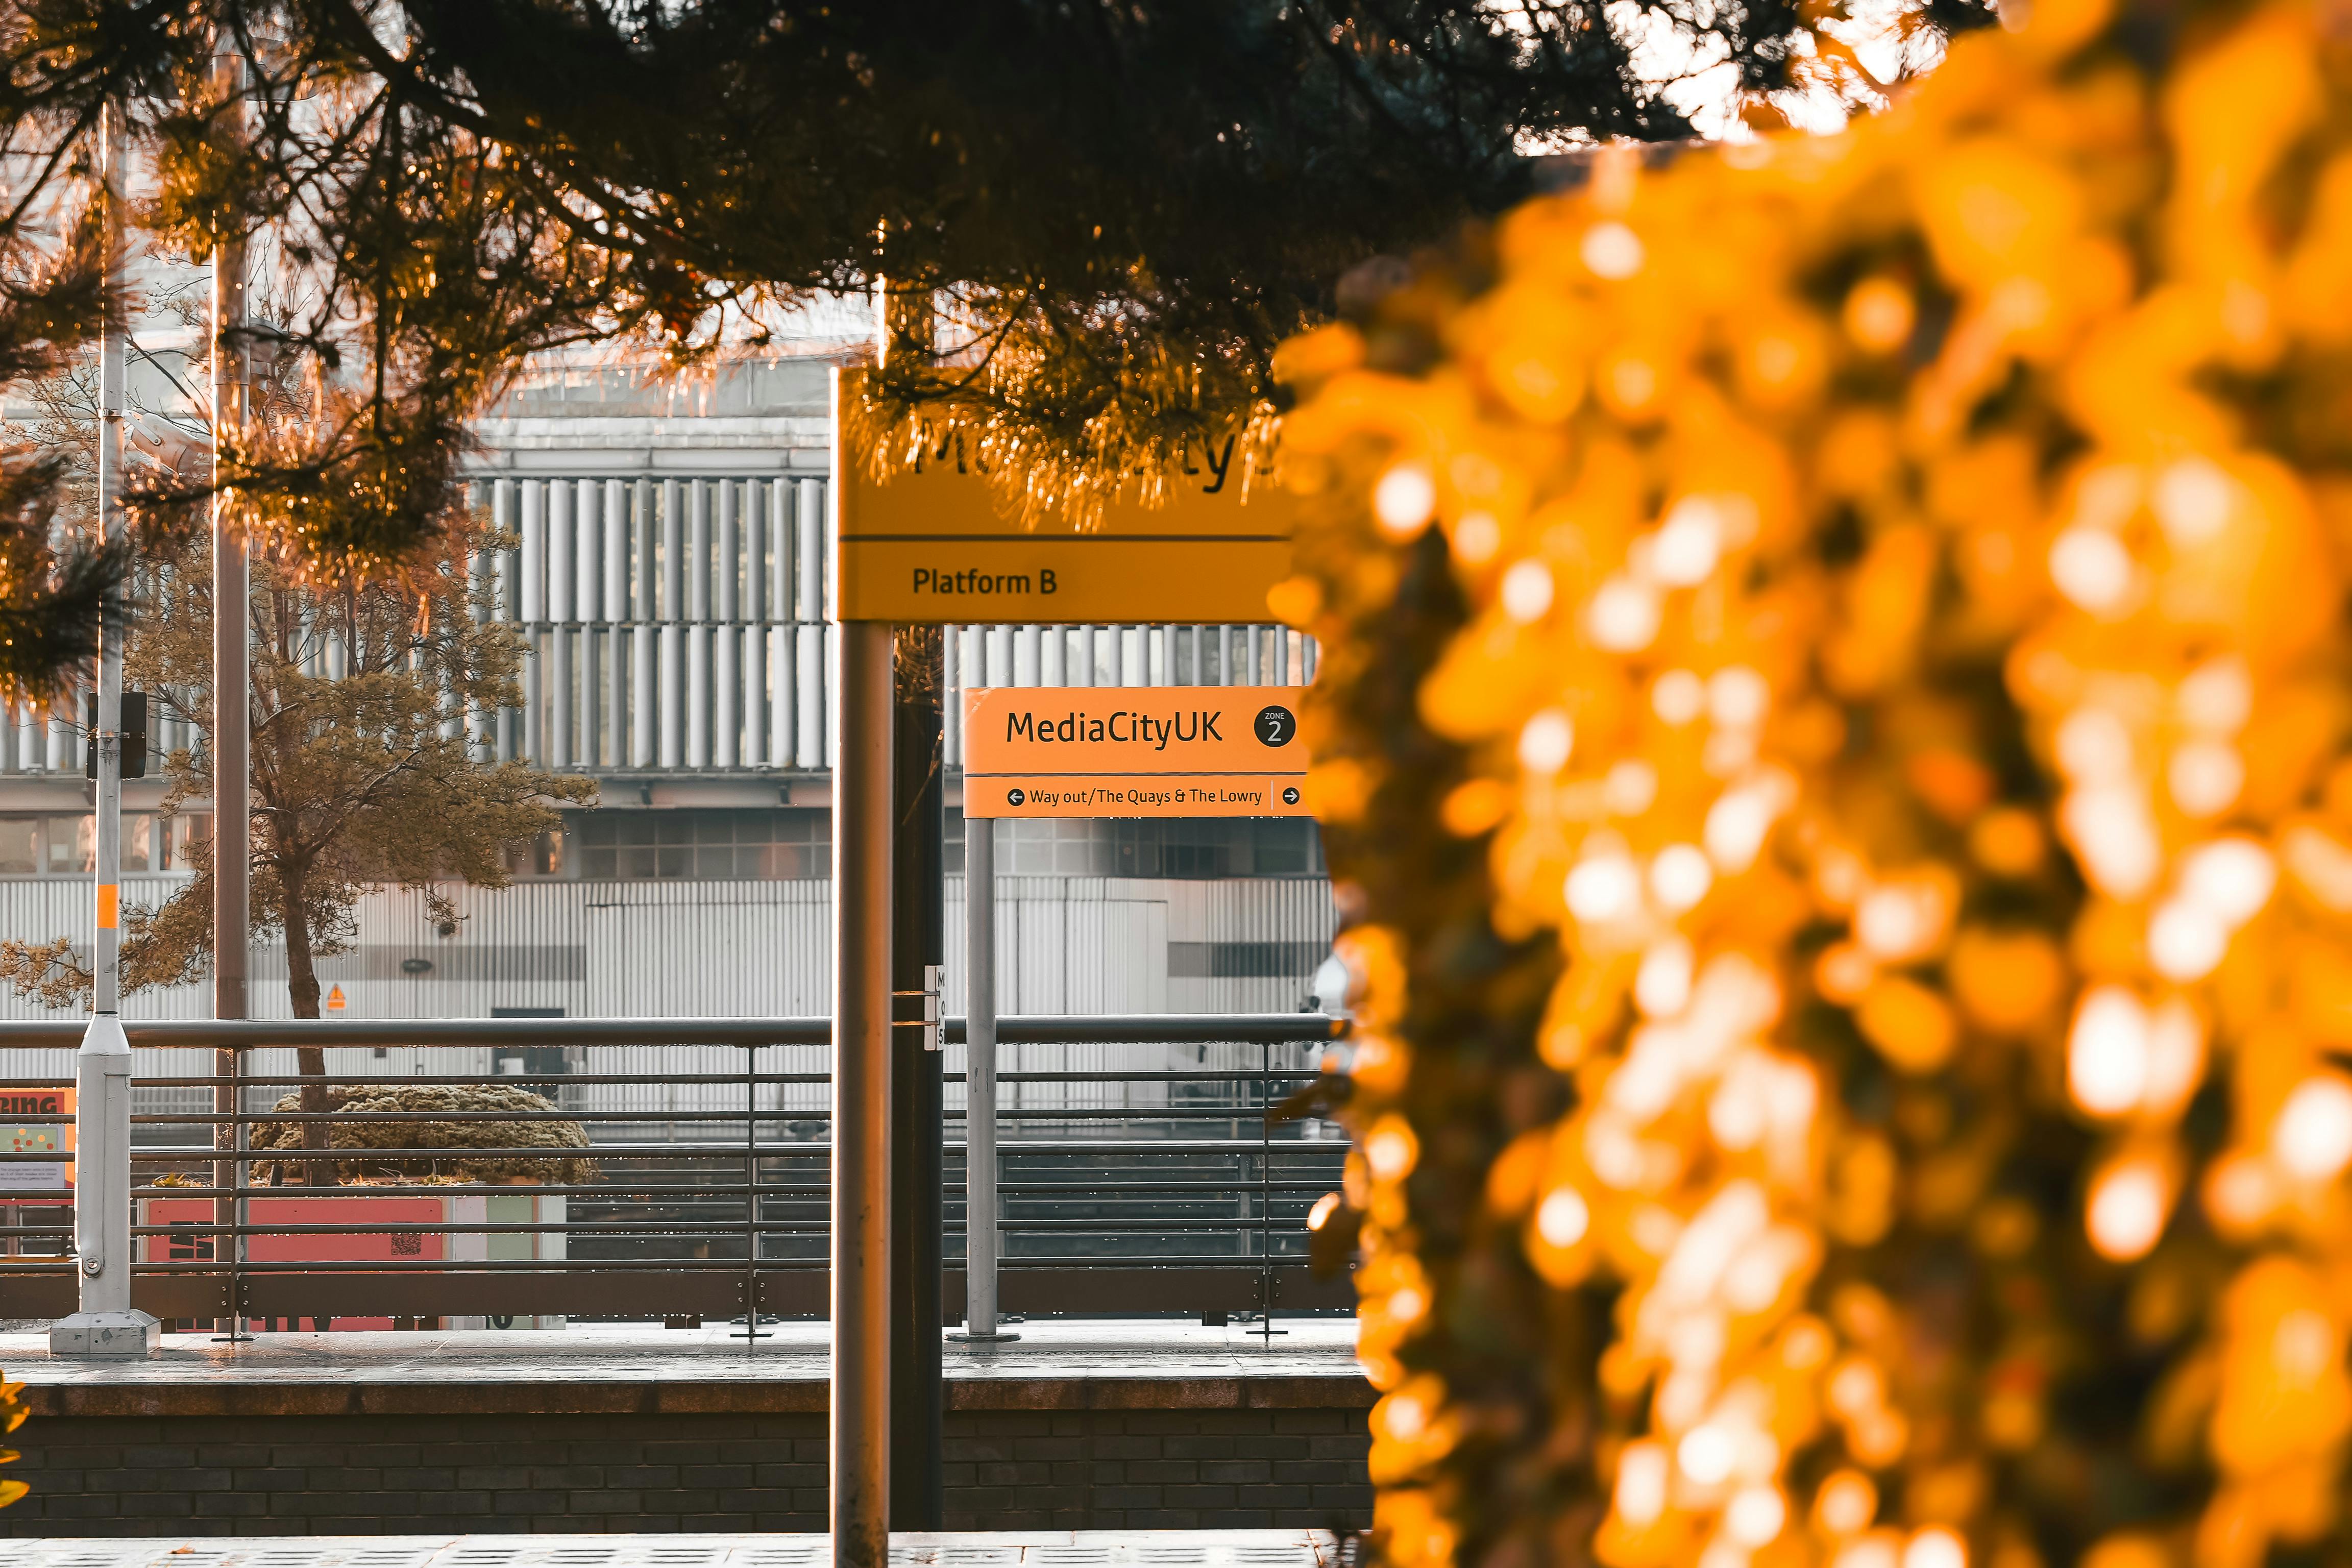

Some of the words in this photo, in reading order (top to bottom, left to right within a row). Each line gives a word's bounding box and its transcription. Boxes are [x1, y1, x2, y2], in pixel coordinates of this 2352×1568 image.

[914, 568, 1030, 594] Platform
[1040, 569, 1057, 595] B
[1007, 711, 1222, 751] MediaCityUK
[1267, 721, 1281, 741] 2
[1030, 790, 1060, 807] Way
[1128, 789, 1170, 806] Quays
[1175, 789, 1186, 802] &
[1189, 789, 1216, 802] The
[1220, 789, 1262, 806] Lowry
